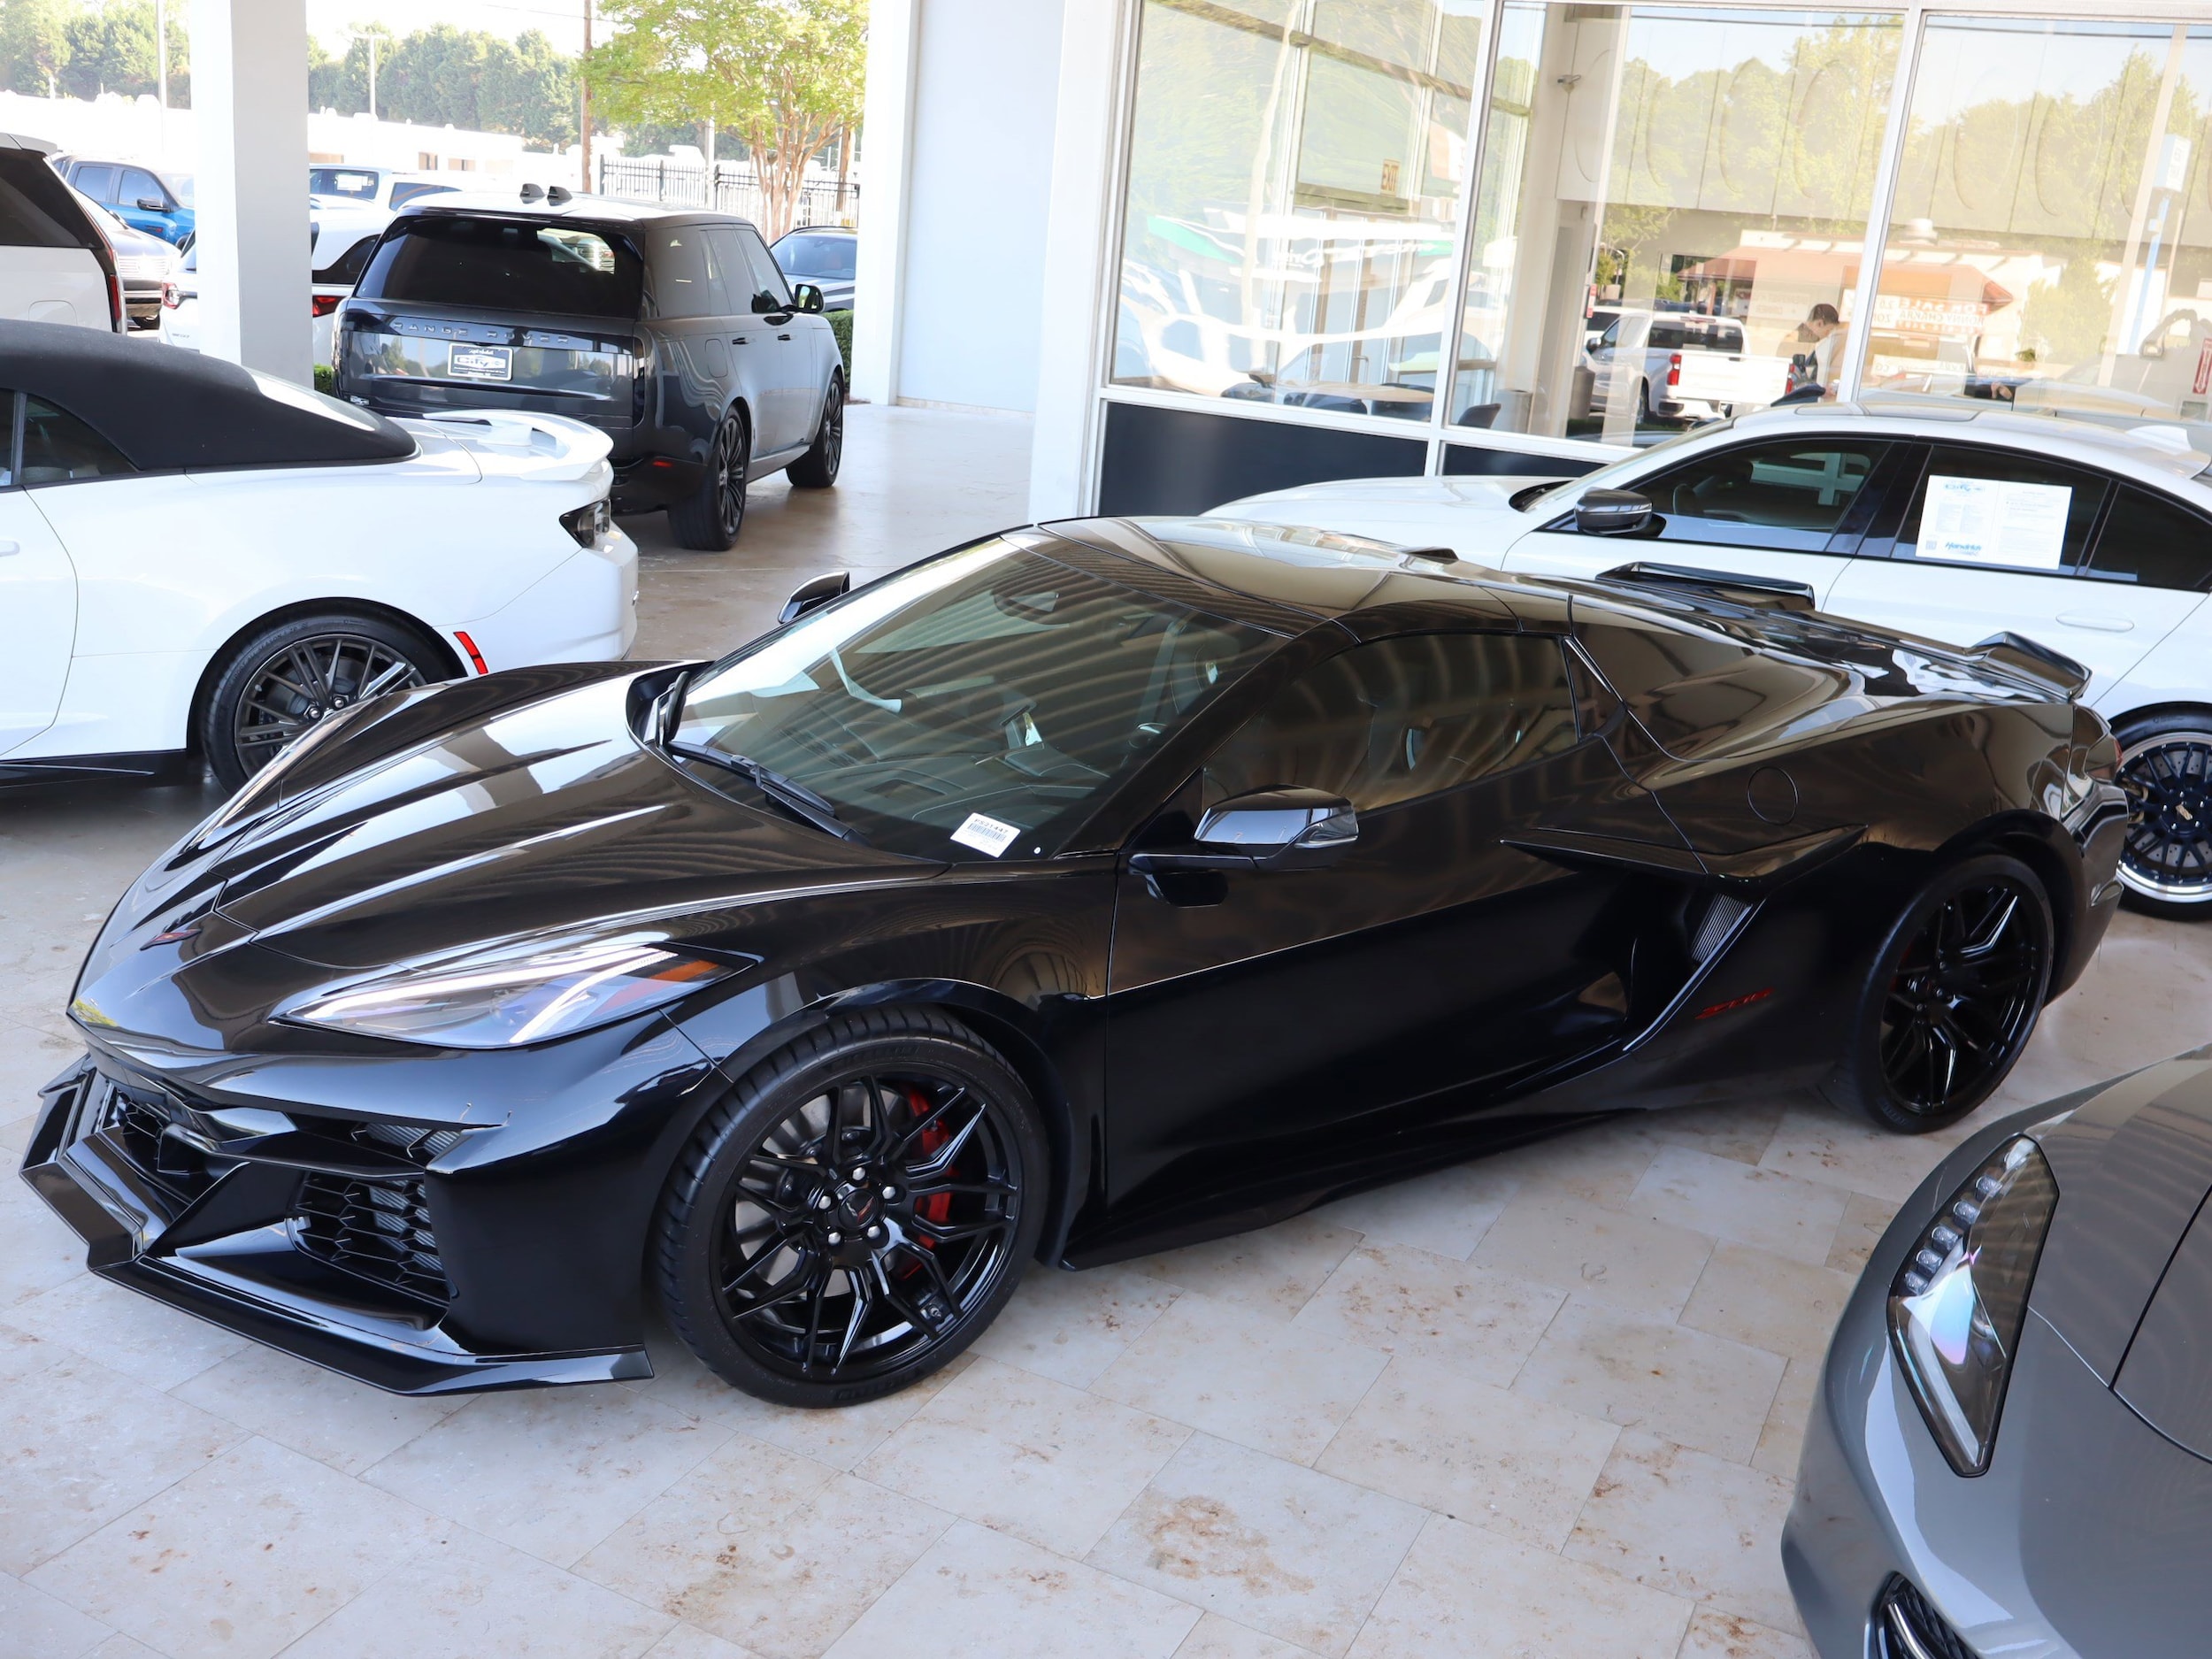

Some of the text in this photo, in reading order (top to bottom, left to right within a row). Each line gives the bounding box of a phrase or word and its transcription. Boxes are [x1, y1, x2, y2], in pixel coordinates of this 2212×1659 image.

[1381, 164, 1399, 191] EXIT
[393, 322, 569, 343] RANGE ROVER
[457, 357, 490, 368] City
